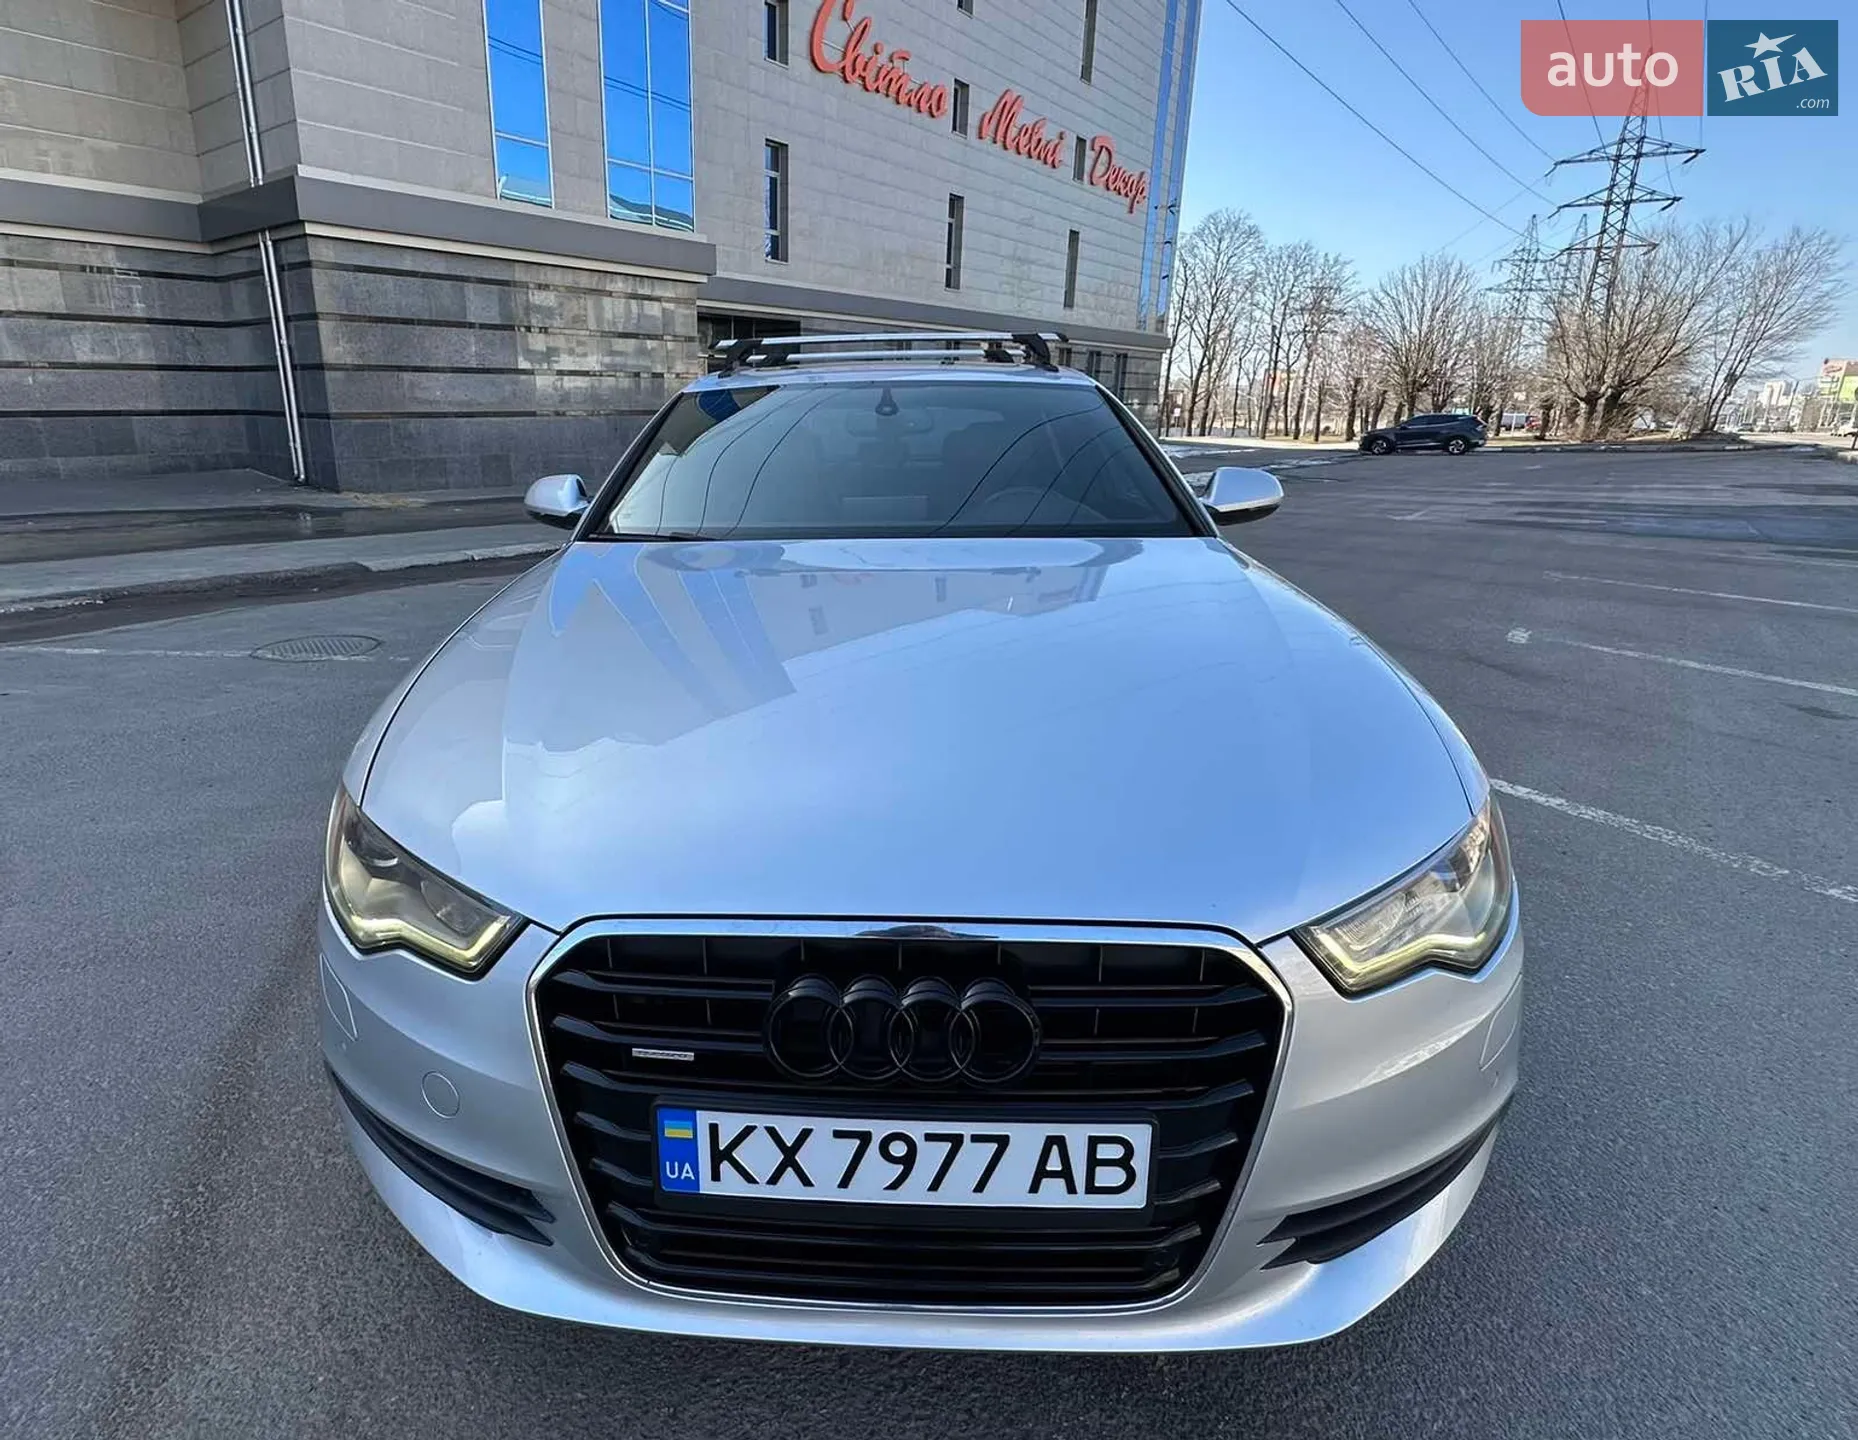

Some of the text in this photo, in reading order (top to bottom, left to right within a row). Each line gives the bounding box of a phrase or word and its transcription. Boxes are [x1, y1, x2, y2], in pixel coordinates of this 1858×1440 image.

[665, 1161, 695, 1180] UA
[708, 1121, 1137, 1195] KX 7977 AB
